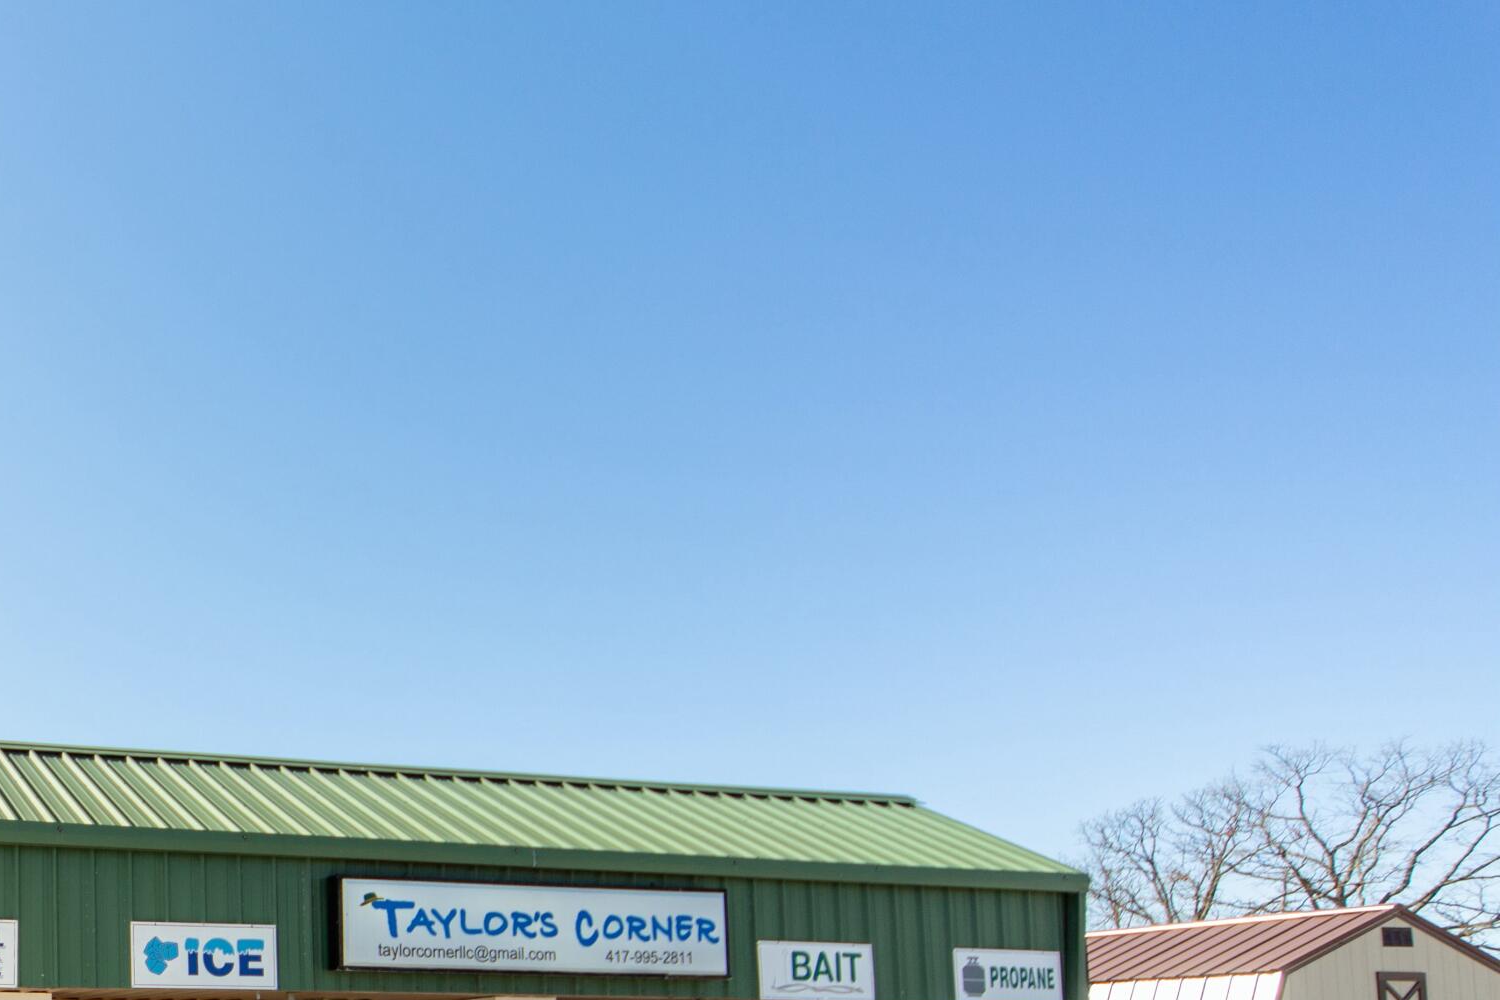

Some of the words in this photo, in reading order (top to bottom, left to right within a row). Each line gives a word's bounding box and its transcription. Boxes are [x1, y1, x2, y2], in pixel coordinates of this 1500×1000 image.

[371, 899, 559, 939] TAYLOR'S
[575, 909, 720, 948] CORNER
[184, 937, 265, 977] ICE
[378, 943, 557, 963] taylorcornerllc@gmail.com
[605, 949, 693, 965] 417-995-2811
[791, 950, 862, 983] BAIT
[990, 965, 1055, 990] PROPANE
